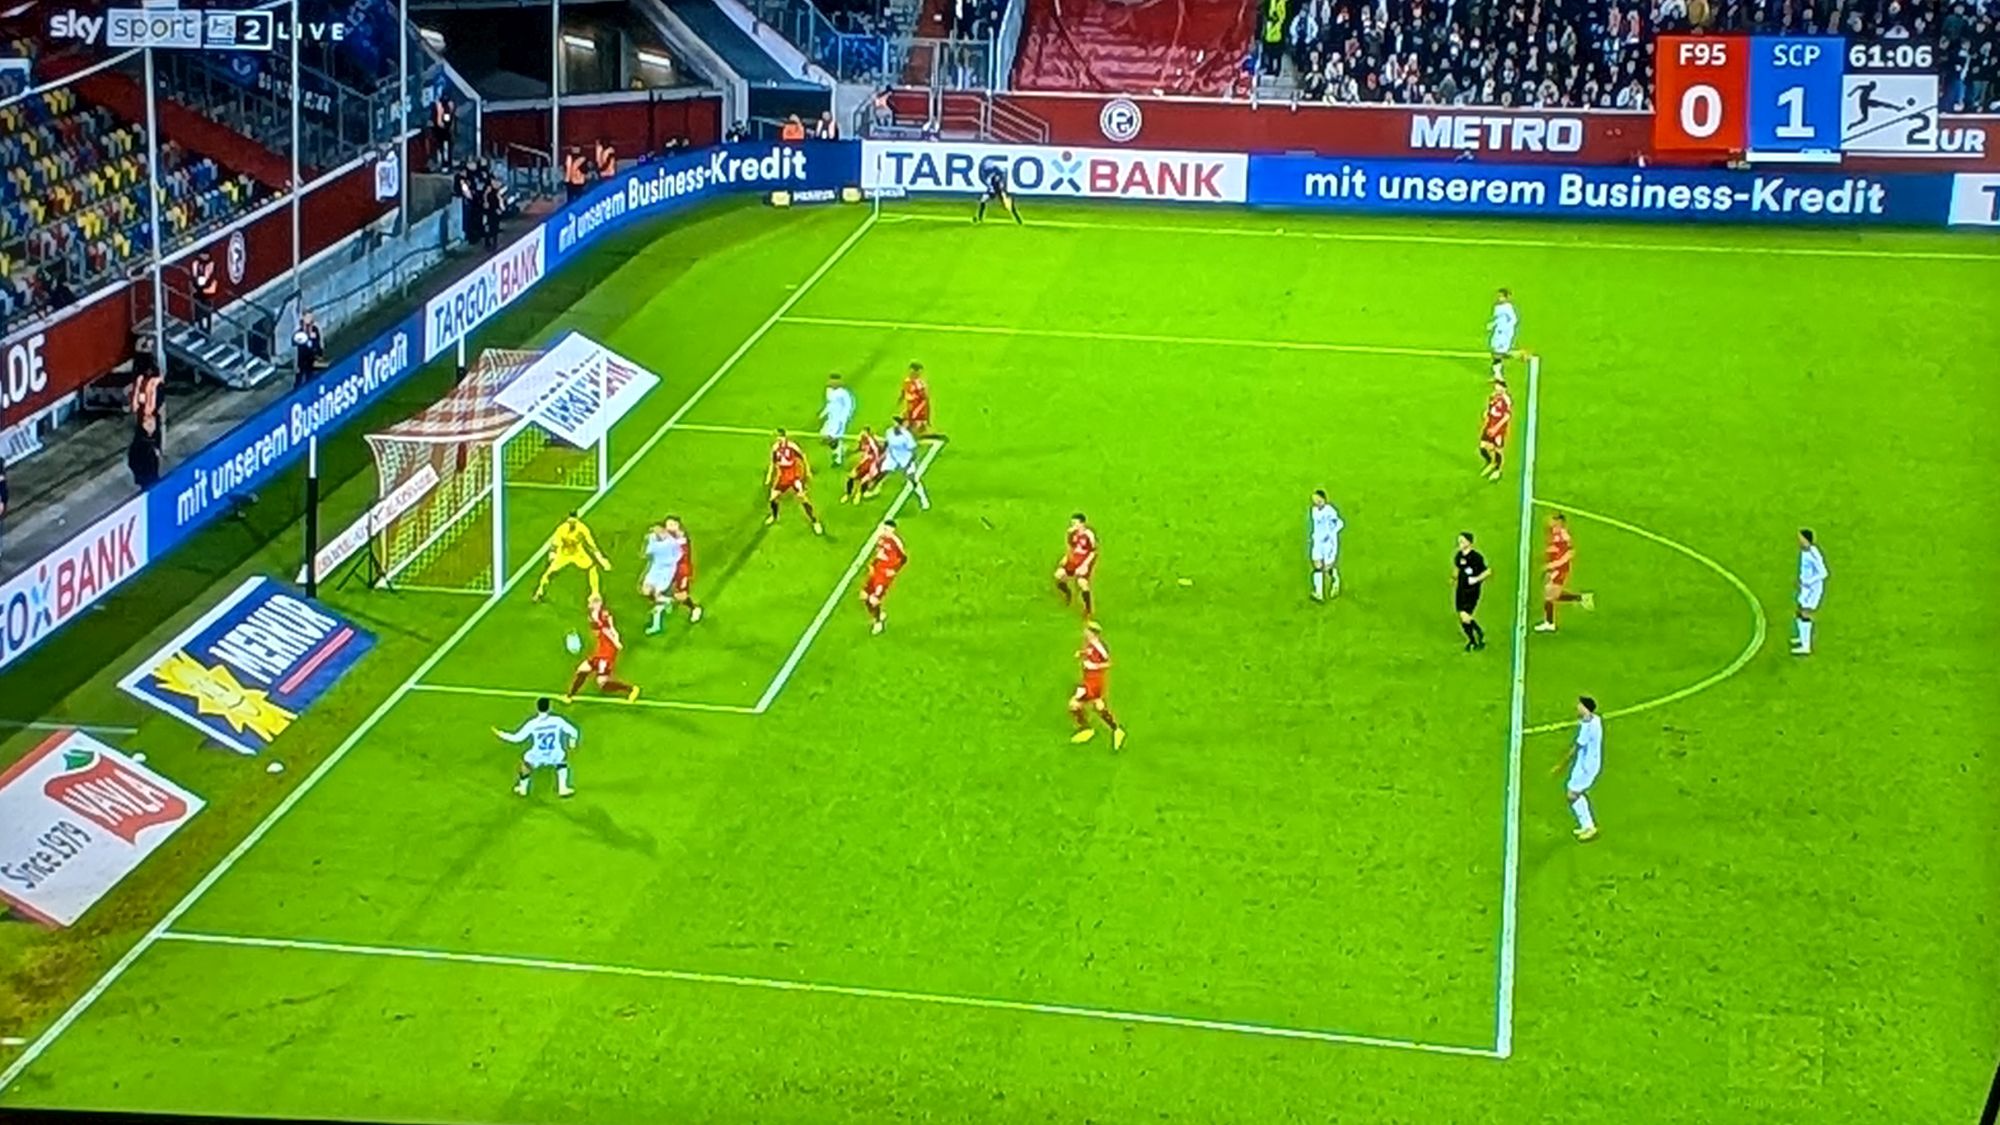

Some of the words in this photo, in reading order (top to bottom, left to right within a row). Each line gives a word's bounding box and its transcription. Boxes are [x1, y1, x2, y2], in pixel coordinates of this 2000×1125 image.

[1409, 113, 1583, 152] METRO
[1940, 127, 1986, 152] UR
[558, 213, 577, 254] mit
[577, 190, 626, 239] unserem
[627, 147, 807, 211] Business-Kredit
[1304, 165, 1367, 199] mit
[1379, 173, 1546, 206] unserem
[1558, 174, 1886, 214] Business-Kredit
[176, 468, 208, 527] mit
[211, 423, 289, 500] unserem
[290, 332, 409, 446] Business-Kredit
[208, 593, 338, 685] MERKUR
[0, 850, 63, 889] Since
[37, 820, 92, 860] 1979
